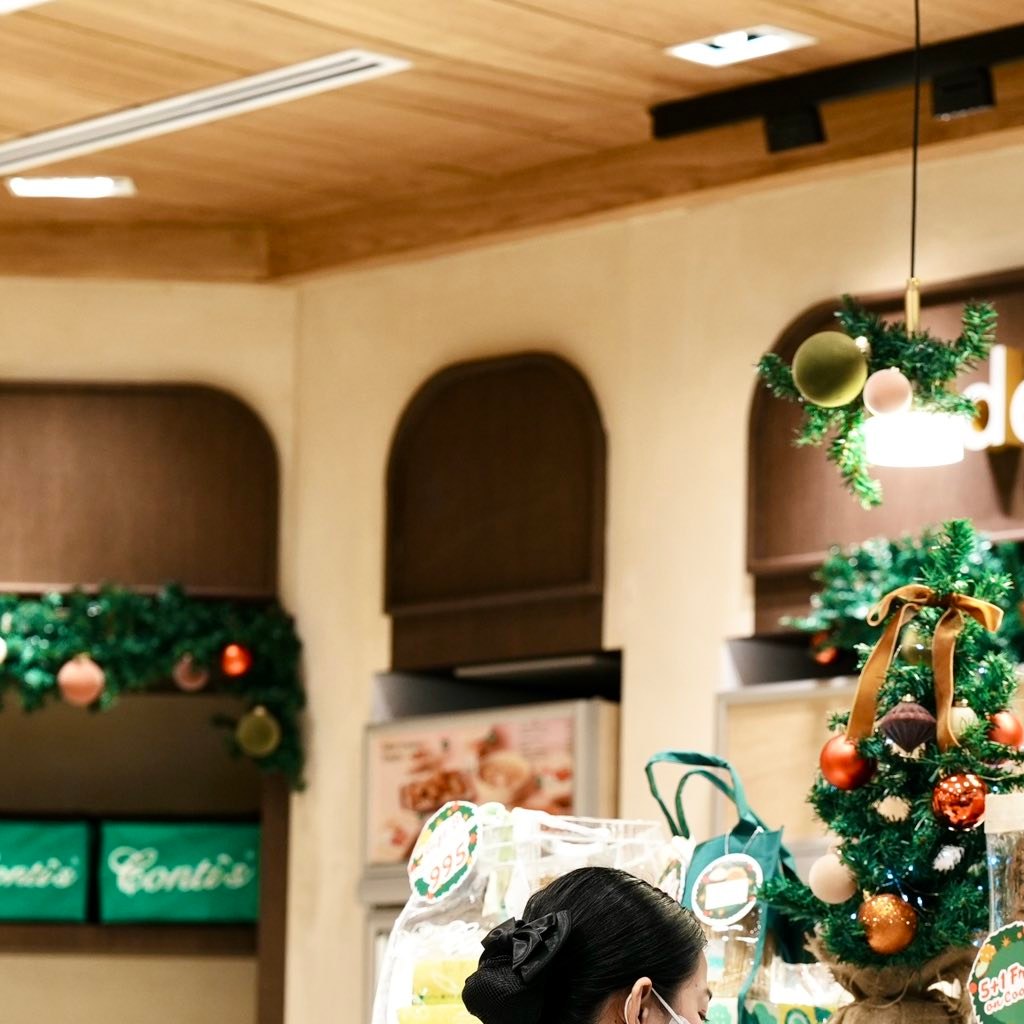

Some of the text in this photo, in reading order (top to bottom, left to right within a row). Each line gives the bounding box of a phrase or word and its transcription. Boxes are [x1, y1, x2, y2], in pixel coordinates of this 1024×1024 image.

[107, 846, 254, 895] Conti's
[980, 971, 1006, 999] 5+1
[986, 999, 1003, 1012] on
